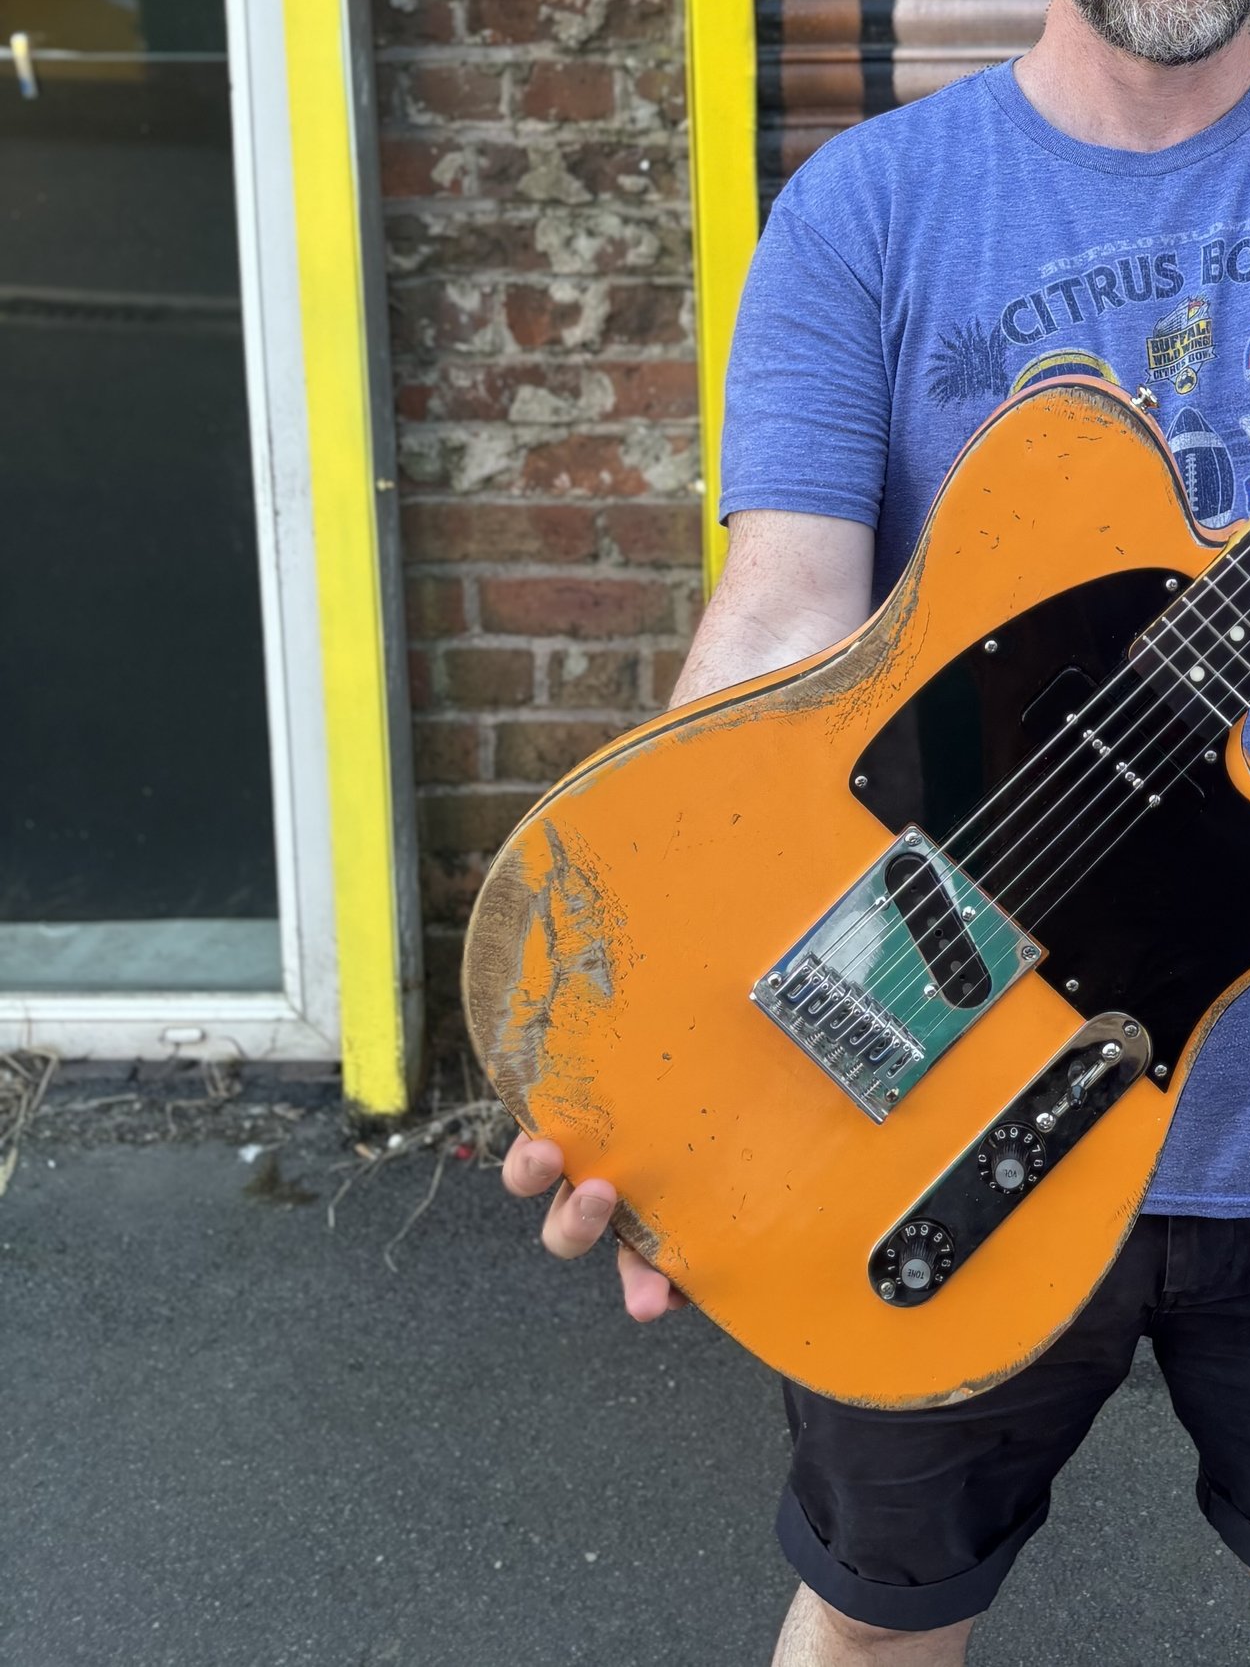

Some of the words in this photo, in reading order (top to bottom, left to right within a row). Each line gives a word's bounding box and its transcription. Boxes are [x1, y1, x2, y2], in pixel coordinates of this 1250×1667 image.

[1001, 251, 1186, 346] CITRUS
[994, 1129, 1006, 1140] 10
[1009, 1127, 1019, 1138] 9
[1023, 1133, 1034, 1144] 8
[1031, 1144, 1042, 1153] 7
[905, 1225, 917, 1236] 10
[920, 1224, 929, 1236] 9
[933, 1232, 943, 1242] 8
[941, 1244, 951, 1252] 7
[907, 1268, 925, 1280] TONE
